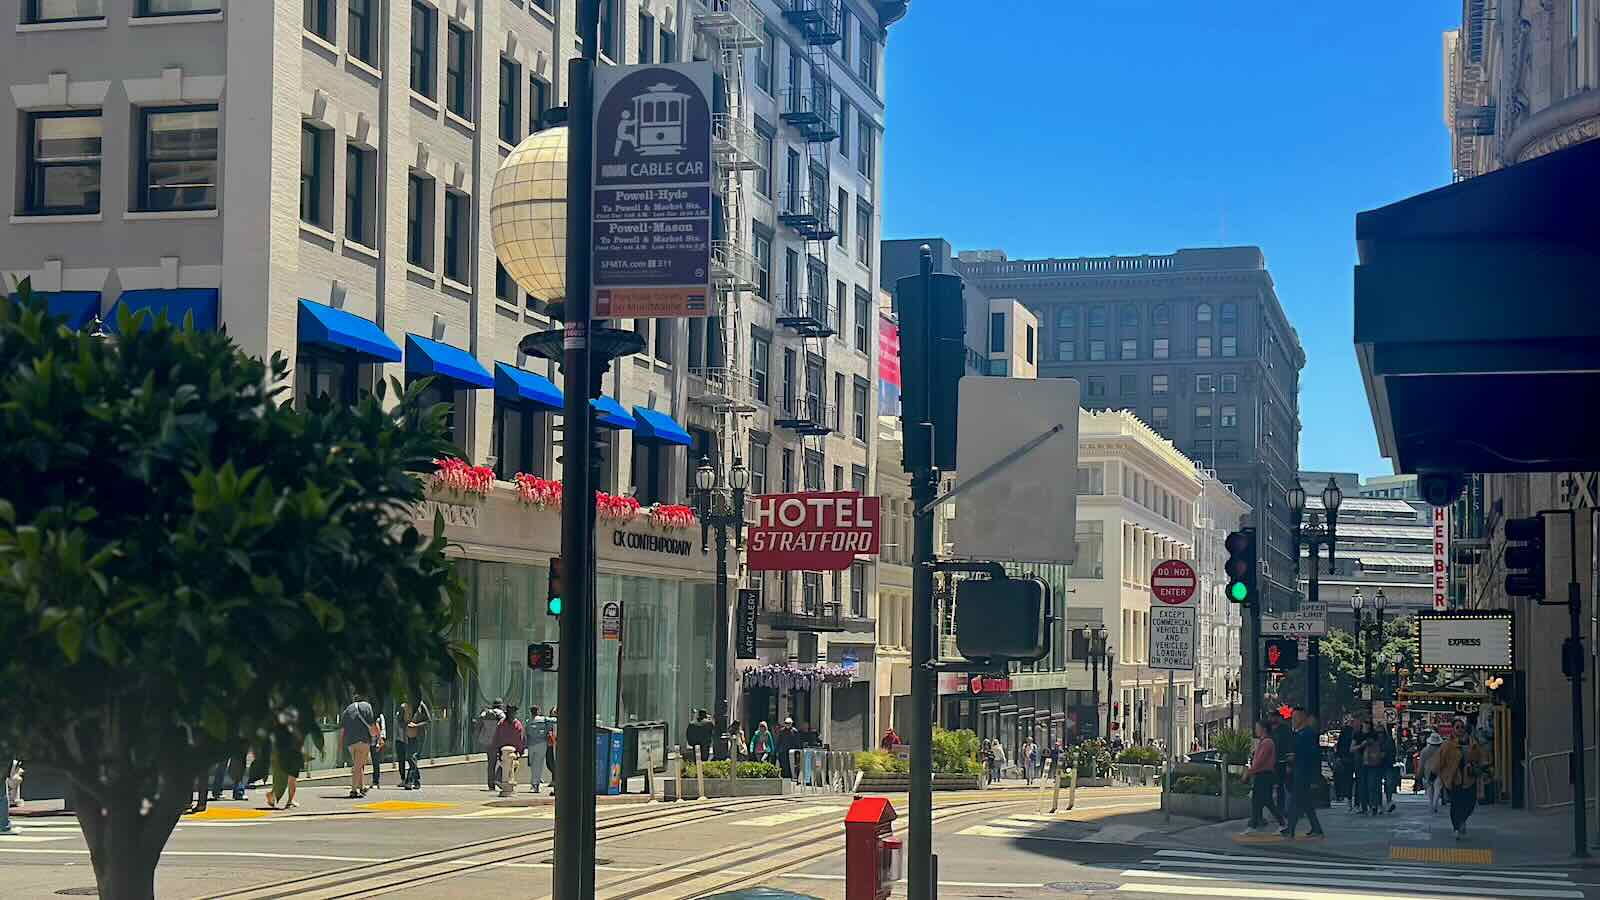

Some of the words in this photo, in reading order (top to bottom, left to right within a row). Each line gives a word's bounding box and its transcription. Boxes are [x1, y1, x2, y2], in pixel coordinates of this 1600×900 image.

[631, 163, 673, 177] CABLE
[676, 161, 704, 176] CAR
[615, 190, 688, 202] Powell-Hyde
[609, 223, 693, 234] Powell-Mason
[754, 498, 873, 528] HOTEL
[752, 531, 873, 552] STRATFORD
[1174, 568, 1189, 576] NOT
[1160, 588, 1186, 597] ENTER
[746, 592, 758, 633] GALLERY
[1160, 610, 1185, 618] EXCEPT
[1152, 618, 1192, 627] COMMERCIAL
[1272, 622, 1313, 631] GEARY
[1156, 626, 1189, 634] VEHICLES
[1156, 642, 1188, 650] VEHICLES
[1447, 638, 1481, 646] EXPRESS
[1156, 649, 1187, 657] LOADING
[1151, 656, 1162, 665] ON
[1164, 657, 1191, 666] POWELL
